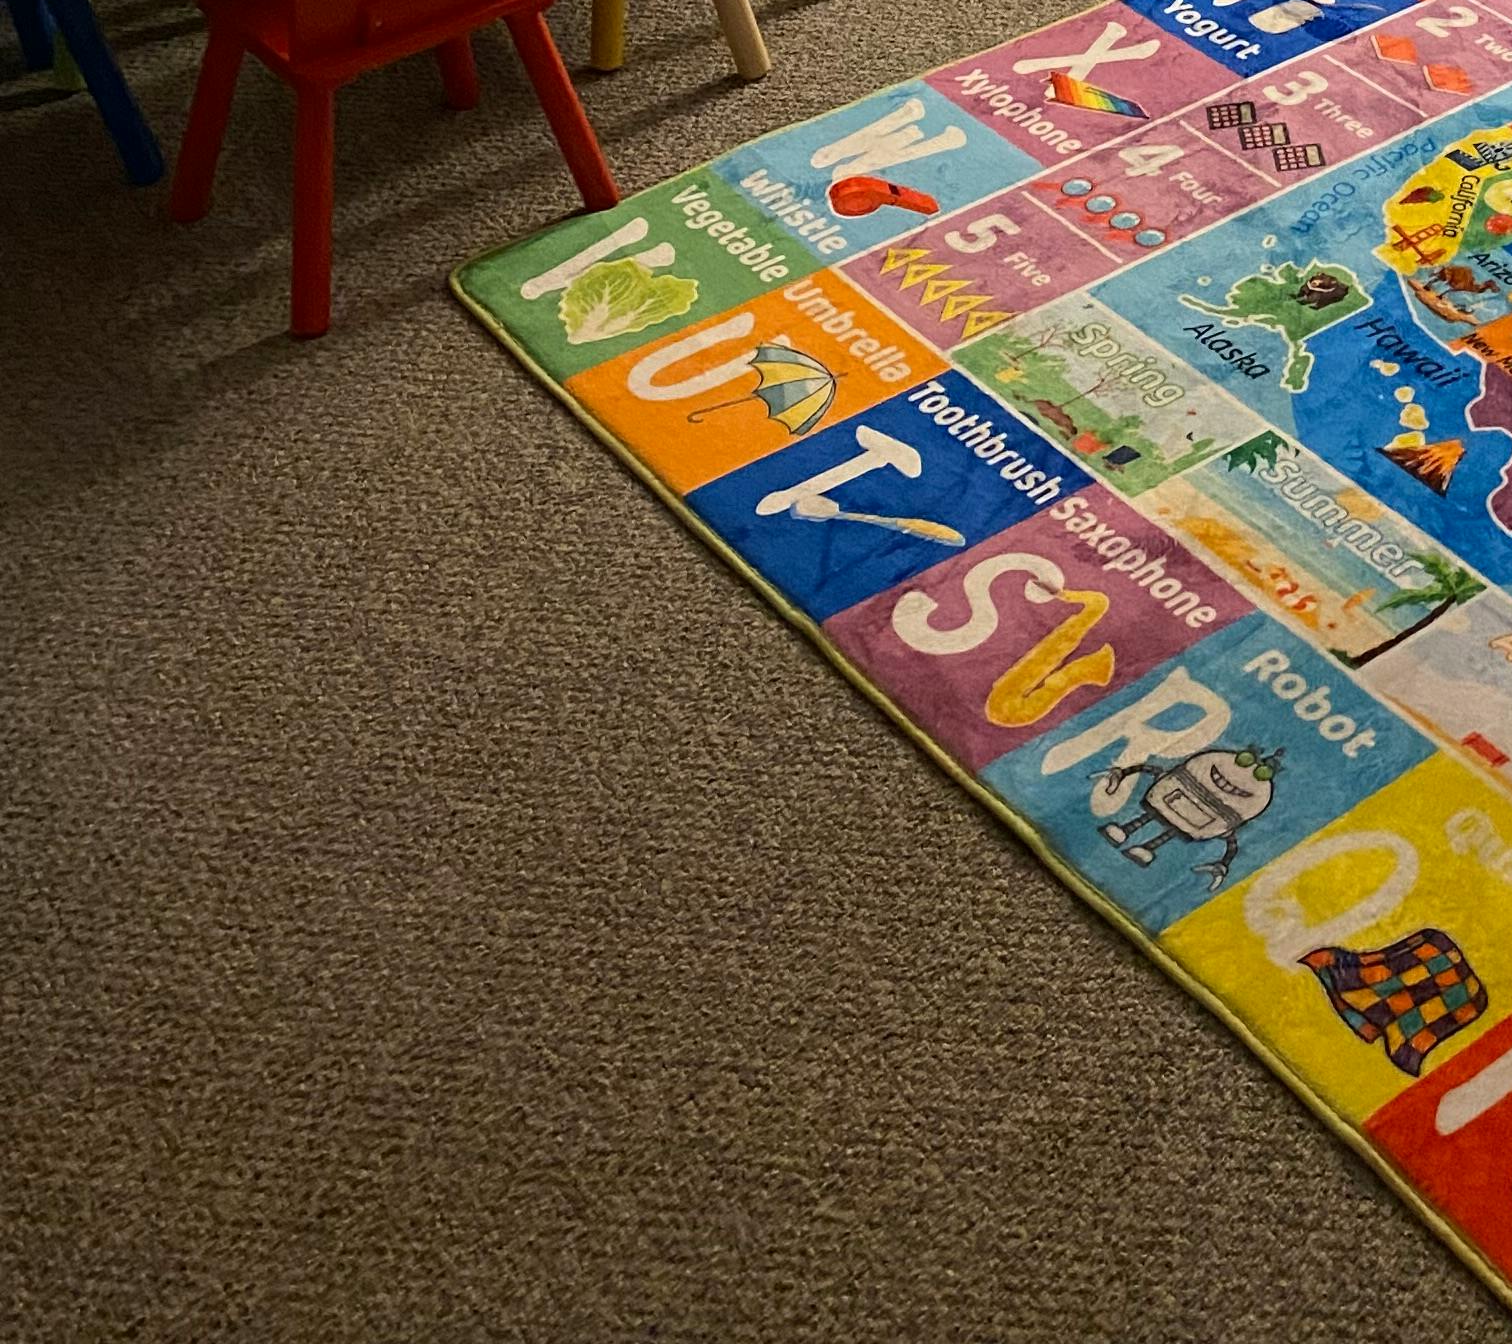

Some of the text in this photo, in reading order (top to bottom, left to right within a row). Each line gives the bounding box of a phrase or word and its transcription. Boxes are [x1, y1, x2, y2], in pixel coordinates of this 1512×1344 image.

[1414, 5, 1480, 39] 2
[953, 67, 1083, 156] Xylophone
[1262, 70, 1330, 106] 3
[1314, 97, 1376, 140] Three
[1117, 143, 1185, 178] 4
[1169, 171, 1224, 207] Four
[1290, 135, 1439, 236] Pacific Ocean
[670, 183, 790, 284] Vegetable
[740, 168, 849, 256] Whistle
[944, 214, 1022, 254] 5
[1441, 173, 1482, 239] California
[1003, 250, 1052, 288] Five
[783, 279, 912, 385] Umbrella
[1067, 320, 1184, 409] Spring
[1183, 321, 1272, 382] Alaska
[1354, 314, 1472, 389] Hawaii
[1460, 331, 1498, 362] New
[907, 379, 1062, 507] Toothbrush
[1257, 453, 1425, 582] Summer
[1050, 494, 1217, 631] Saxophone
[1242, 649, 1377, 760] Robot
